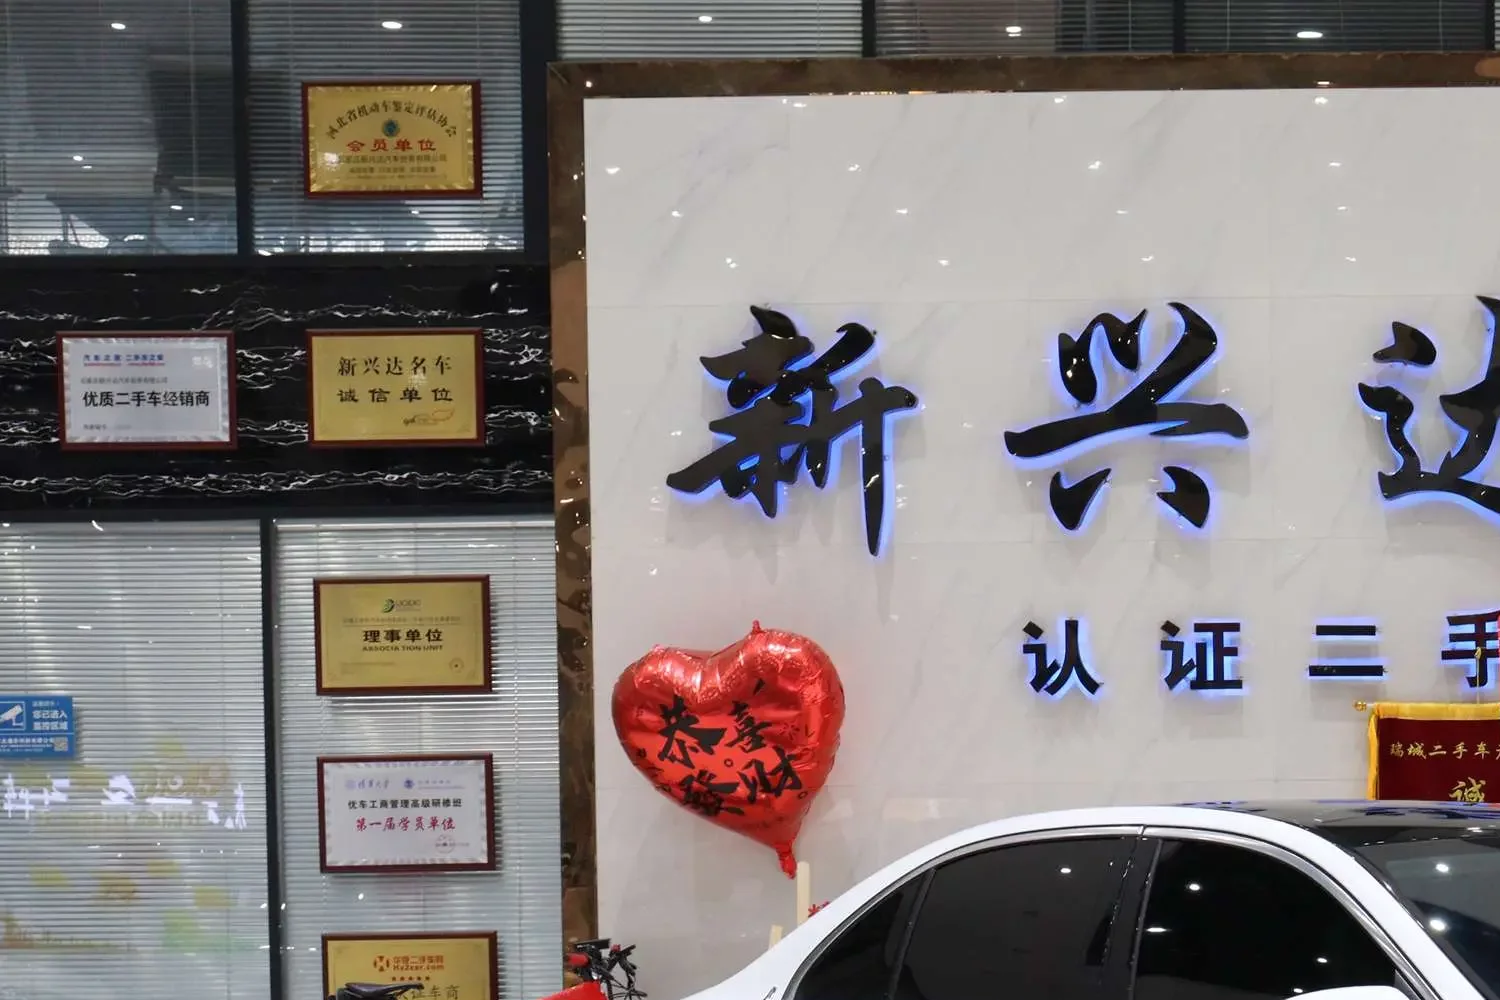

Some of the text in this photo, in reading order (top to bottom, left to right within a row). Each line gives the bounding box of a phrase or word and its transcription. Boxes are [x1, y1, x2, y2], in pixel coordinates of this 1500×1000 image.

[346, 138, 436, 152] 会员单位
[338, 355, 452, 376] 新兴达名车
[83, 391, 210, 407] 优质二手车经销商
[337, 388, 453, 403] 诚信单位
[362, 628, 443, 643] 理事单位
[356, 816, 456, 831] 第一届学员单位
